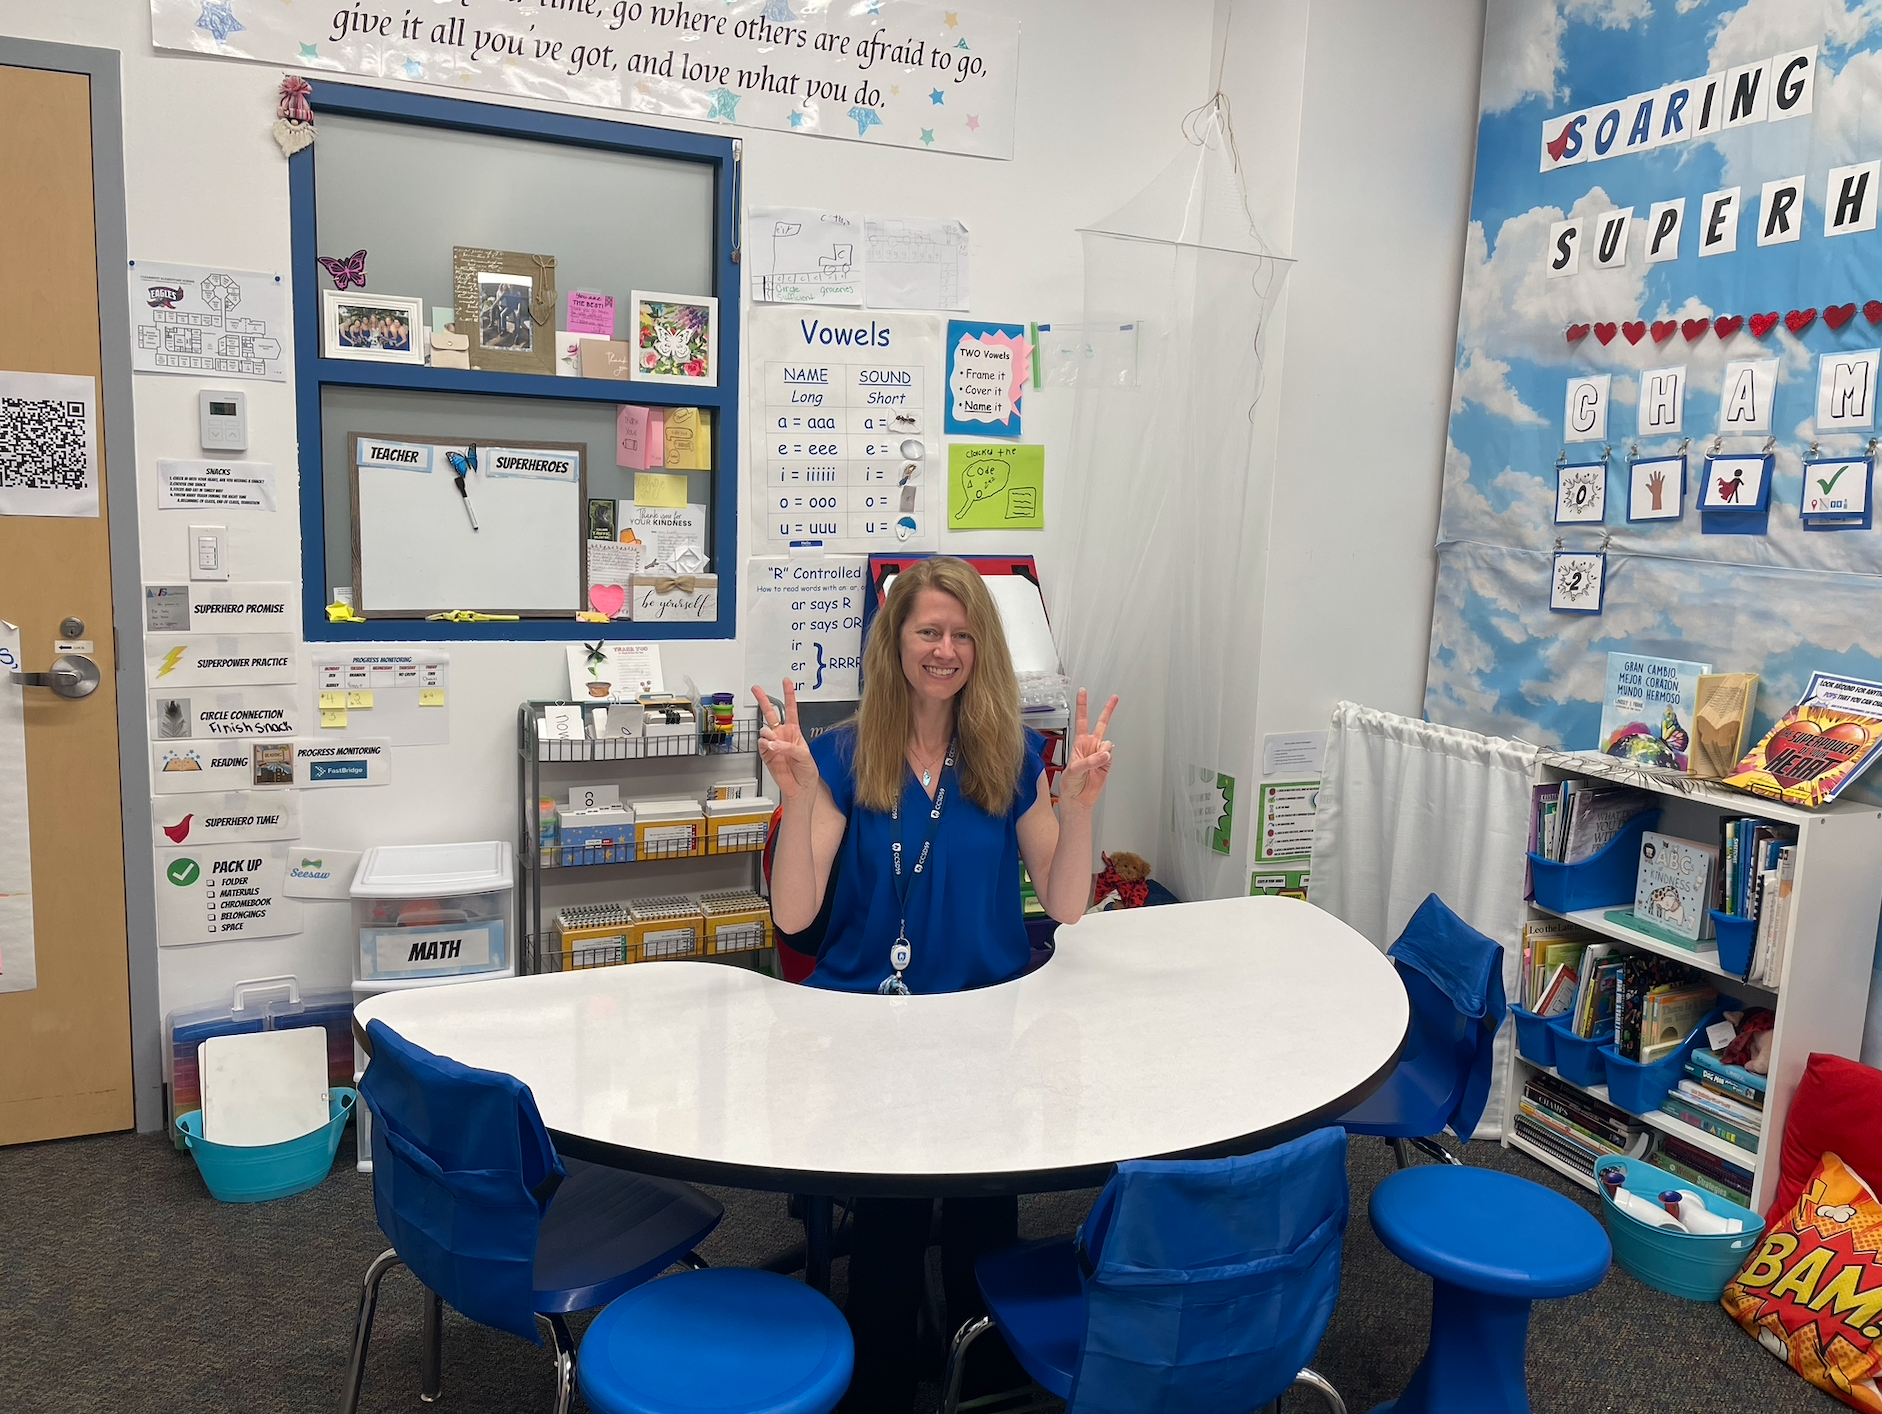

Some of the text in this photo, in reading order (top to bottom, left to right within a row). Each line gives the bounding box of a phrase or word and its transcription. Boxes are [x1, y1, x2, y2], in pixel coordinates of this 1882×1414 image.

[609, 0, 642, 30] go
[650, 2, 727, 36] where
[734, 17, 807, 48] others
[814, 32, 850, 55] are
[856, 29, 925, 70] afraid
[930, 46, 952, 70] to
[953, 57, 988, 83] go,
[329, 3, 886, 109] give it all you've got, and love what you do.
[1562, 56, 1809, 160] SOARING
[1551, 170, 1870, 271] SUPERH
[150, 289, 178, 301] EAGLES
[800, 318, 891, 347] Vowels
[960, 348, 1010, 360] TWO Vowels
[783, 367, 828, 382] NAME
[859, 370, 912, 384] SOUND
[966, 368, 1006, 381] Frame it
[965, 385, 1002, 396] Cover it
[1571, 360, 1870, 433] CHAM
[791, 390, 823, 407] Long
[866, 392, 906, 405] Short
[964, 400, 1002, 412] Name it
[778, 416, 836, 429] a aaa
[864, 418, 874, 430] a
[370, 446, 419, 463] TEACHER
[778, 444, 838, 455] e eee
[866, 444, 876, 455] e
[206, 467, 231, 476] SNACKS
[495, 456, 570, 474] SUPERHEROES
[779, 497, 837, 509] o ooo
[865, 496, 874, 508] o
[636, 508, 659, 520] Thank
[660, 512, 672, 521] you
[630, 518, 692, 527] YOUR KINDNESS
[780, 522, 837, 535] u uuu
[866, 521, 875, 533] u
[793, 565, 861, 580] Controlled
[757, 585, 772, 593] How
[783, 585, 799, 593] read
[801, 584, 821, 593] words
[822, 584, 837, 592] with
[194, 603, 285, 614] SUPERHERO PROMISE
[638, 590, 713, 618] be yourself
[791, 597, 851, 613] ar says R
[791, 617, 862, 633] or says OR
[791, 639, 802, 651] ir
[197, 657, 288, 669] SUPERPOWER PRACTICE
[791, 661, 805, 671] er
[1624, 661, 1644, 673] GRAN
[1619, 672, 1642, 685] MEJOR
[1820, 680, 1833, 688] LOOK
[1834, 682, 1856, 692] AROUND
[1855, 685, 1866, 693] FOR
[1617, 685, 1681, 704] MUNDO HERMOSO
[1837, 693, 1851, 701] THAT
[1851, 696, 1861, 704] YOU
[1861, 698, 1873, 706] CAN
[200, 709, 284, 721] CIRCLE CONNECTION
[1788, 731, 1860, 756] SUPERPOWER
[297, 746, 381, 757] PROGRESS MONITORING
[211, 757, 249, 768] READING
[1763, 748, 1843, 781] HEART
[327, 767, 363, 775] FastBridge
[205, 815, 280, 828] SUPERHERO TIME!
[212, 858, 262, 874] PACK UP
[290, 868, 331, 879] Seesaw
[221, 877, 248, 886] FOLDER
[219, 887, 260, 898] MATERIALS
[220, 897, 272, 909] CHROMEBOOK
[221, 910, 266, 921] BELONGINGS
[221, 922, 244, 932] SPACE
[1529, 926, 1544, 935] Leo
[1545, 924, 1557, 933] the
[407, 939, 462, 962] MATH
[1697, 1175, 1727, 1197] Strategies
